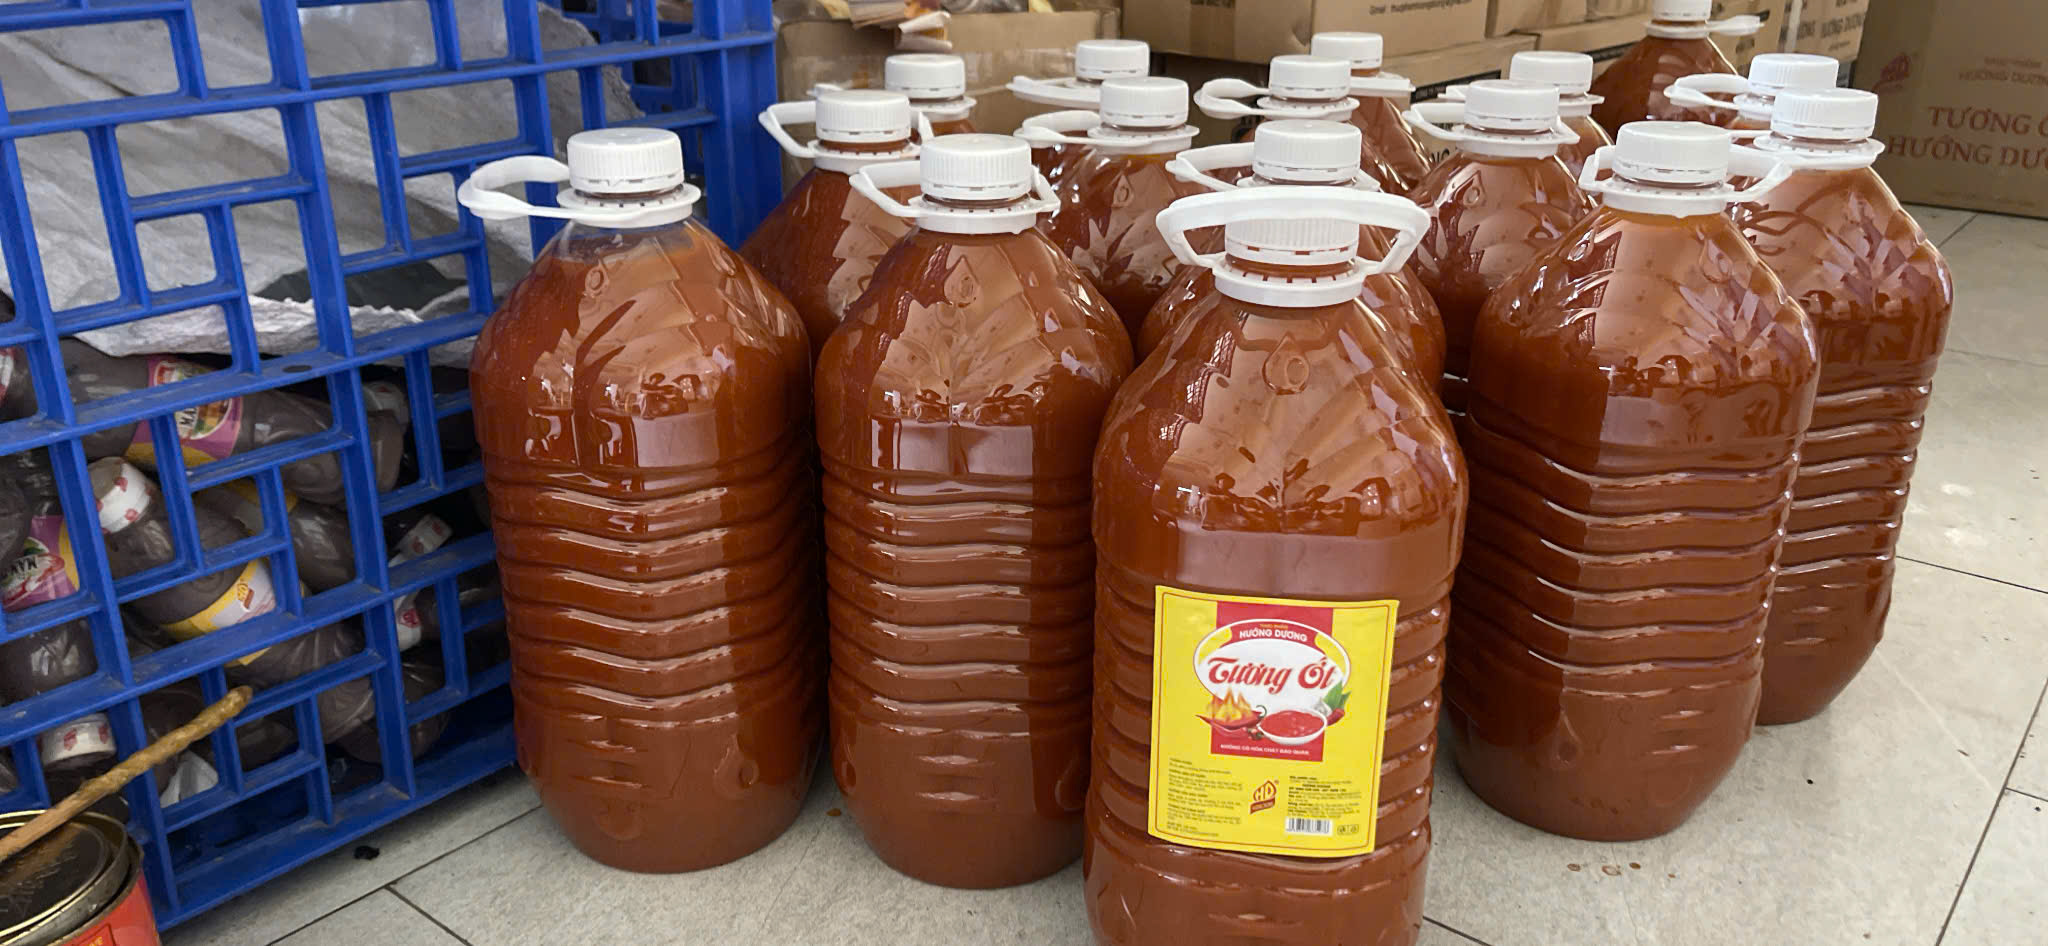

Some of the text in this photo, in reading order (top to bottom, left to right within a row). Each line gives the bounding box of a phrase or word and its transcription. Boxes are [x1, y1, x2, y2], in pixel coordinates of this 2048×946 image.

[1928, 105, 2032, 135] TƯƠNG
[1999, 146, 2048, 170] DƯ
[1239, 628, 1308, 642] HƯỚNG DƯƠNG
[1208, 657, 1293, 695] Tương
